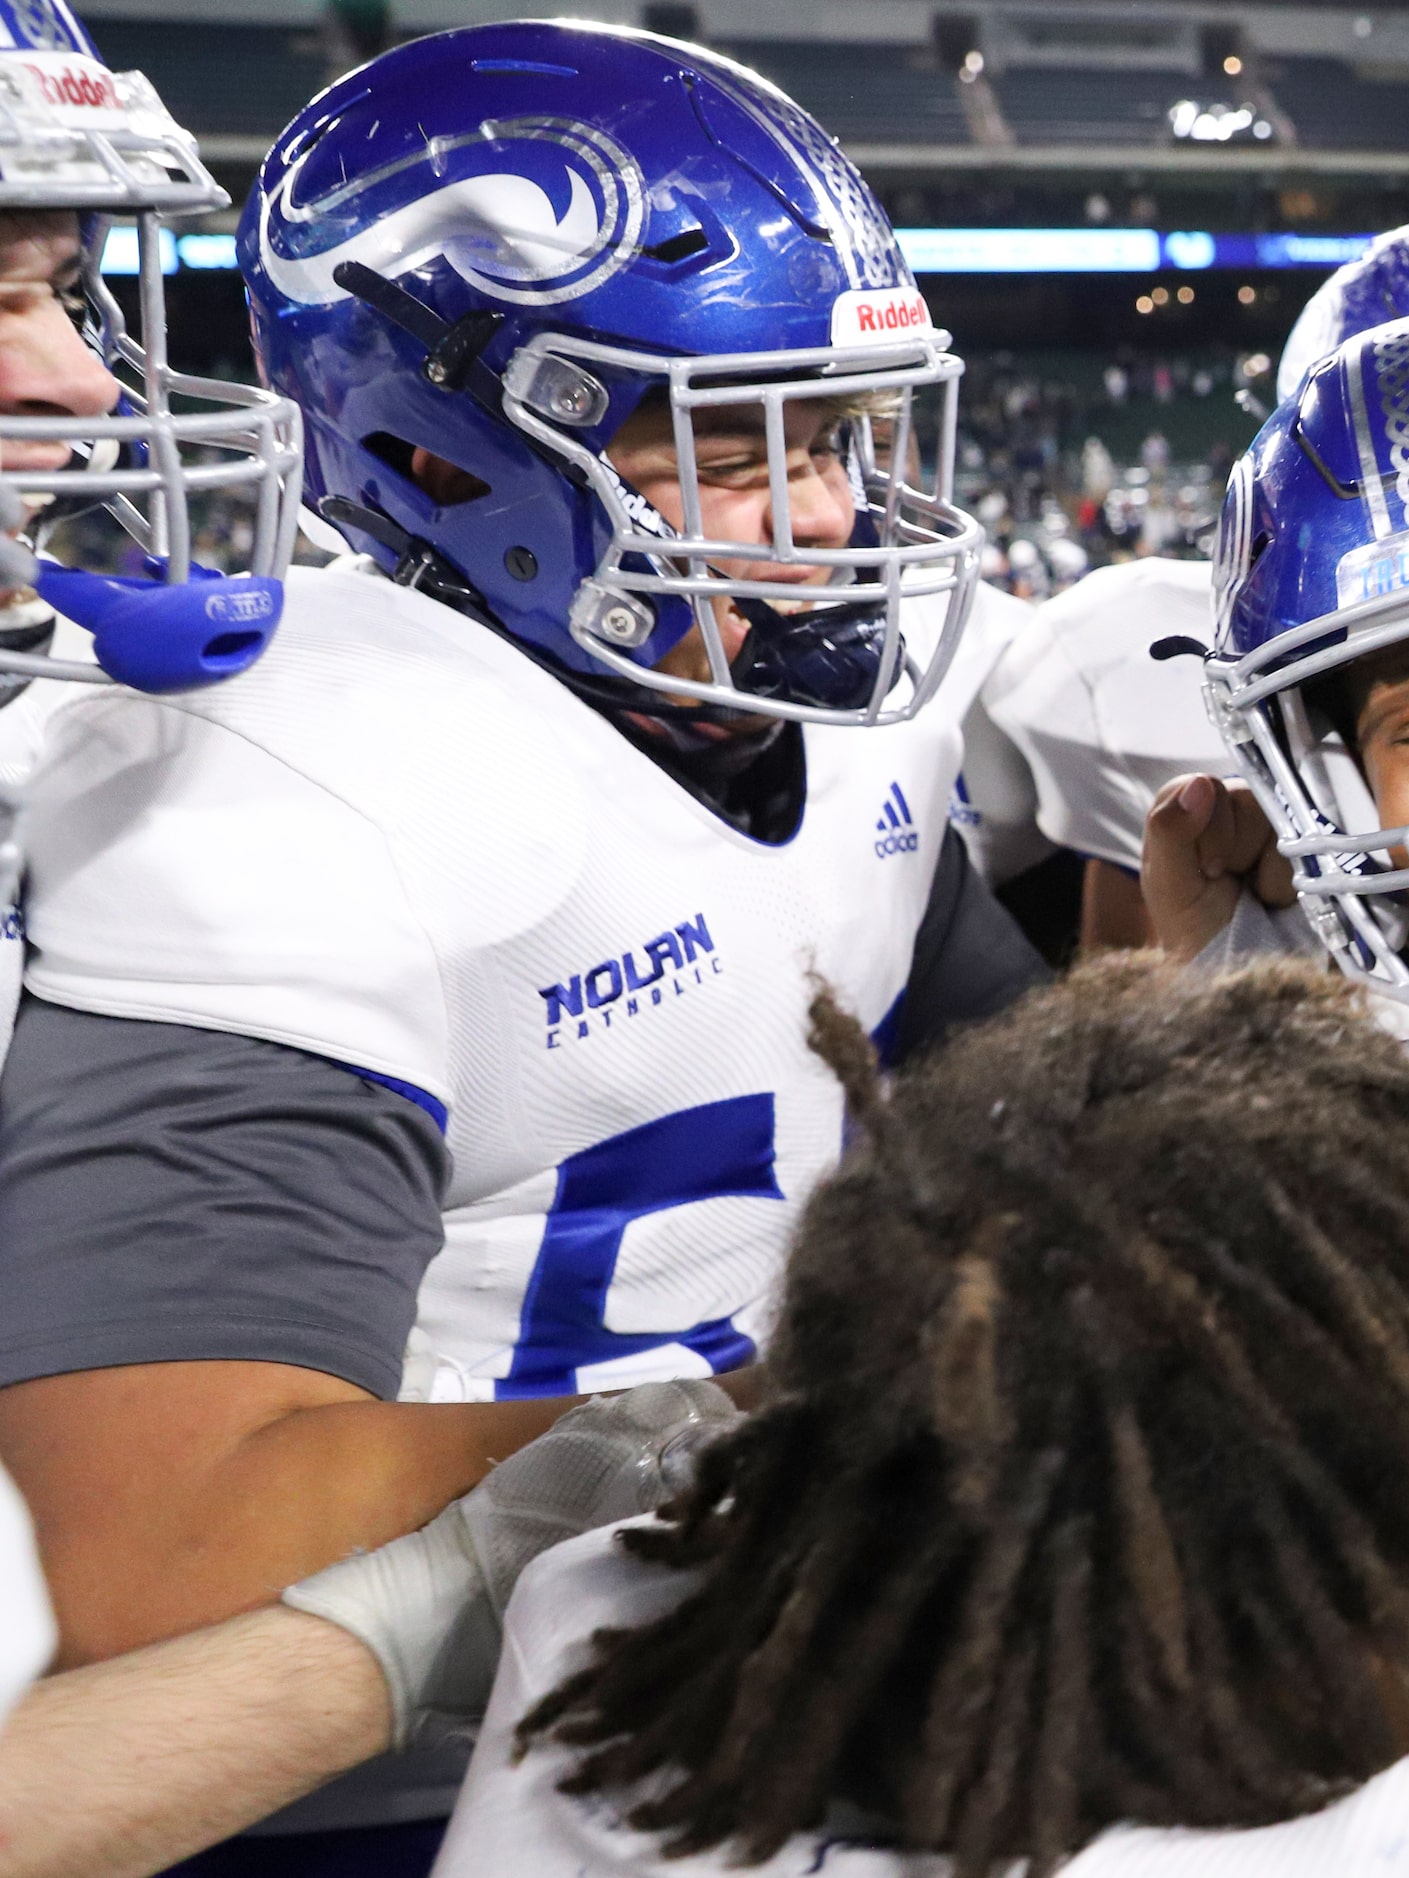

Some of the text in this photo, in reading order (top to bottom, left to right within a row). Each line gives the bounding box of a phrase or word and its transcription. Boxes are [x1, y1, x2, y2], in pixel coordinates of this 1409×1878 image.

[856, 297, 927, 331] Riddell
[538, 912, 715, 1026] NOLAN
[547, 957, 723, 1049] CATHOLIC
